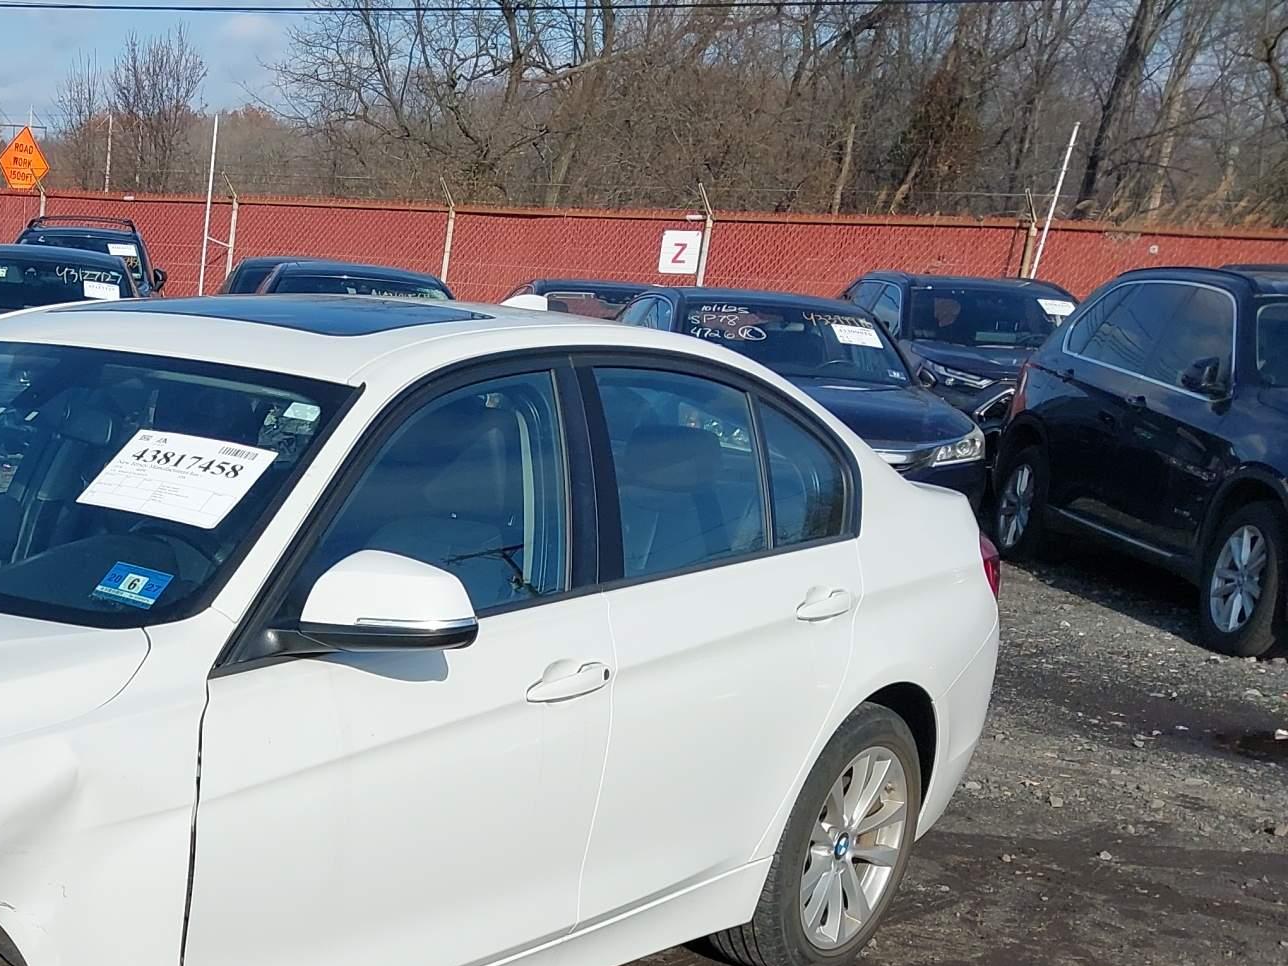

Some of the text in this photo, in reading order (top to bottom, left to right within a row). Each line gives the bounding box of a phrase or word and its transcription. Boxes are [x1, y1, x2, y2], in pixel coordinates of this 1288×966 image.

[14, 142, 34, 155] ROAD
[12, 156, 33, 169] WORK
[671, 242, 688, 264] Z
[133, 447, 245, 480] 43817458
[127, 577, 141, 591] 6
